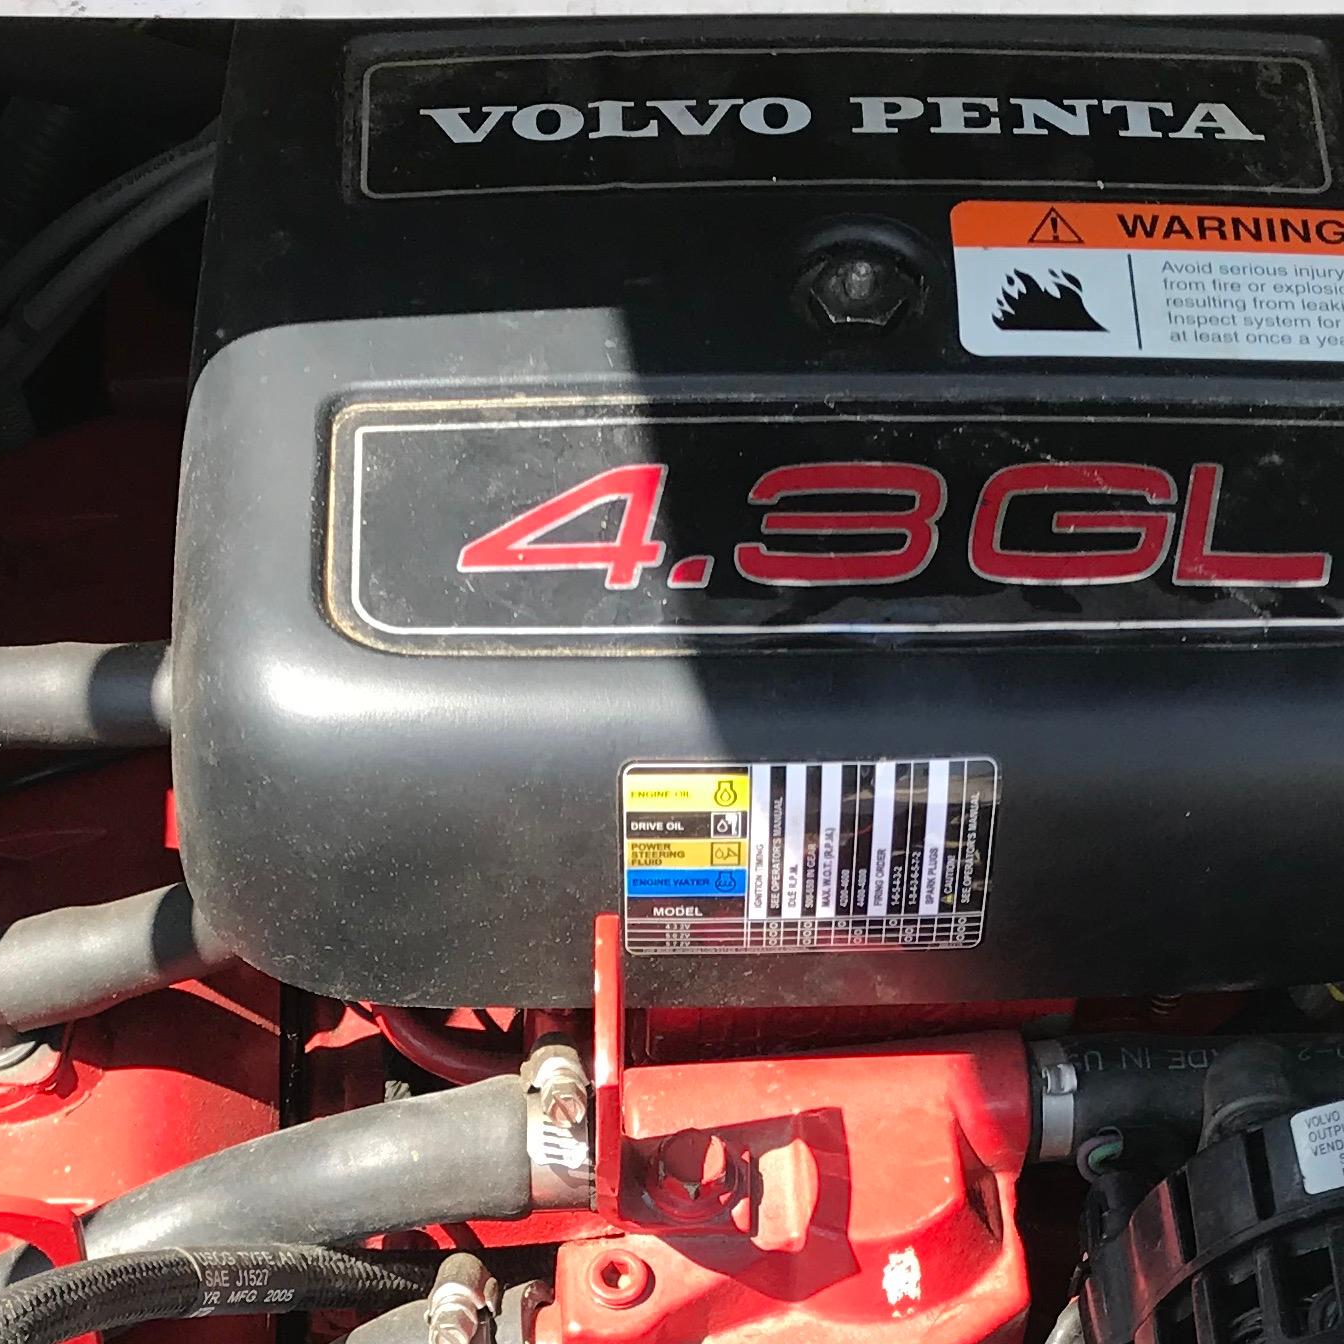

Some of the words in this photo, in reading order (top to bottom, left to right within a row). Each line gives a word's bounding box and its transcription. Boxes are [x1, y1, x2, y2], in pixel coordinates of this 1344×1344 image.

[419, 97, 813, 143] VOLVO
[849, 96, 1265, 142] PENTA
[1161, 260, 1213, 274] Avoid
[1219, 262, 1288, 277] serious
[1293, 264, 1344, 281] injury
[1163, 278, 1205, 292] from
[1212, 279, 1241, 292] fire
[1247, 282, 1266, 293] or
[1166, 295, 1247, 312] resulting
[1252, 296, 1295, 311] from
[1168, 312, 1237, 327] Inspect
[1243, 314, 1312, 330] system
[1317, 315, 1341, 329] for
[1170, 331, 1187, 343] at
[1194, 330, 1240, 343] least
[1246, 333, 1292, 345] once
[1299, 335, 1311, 345] a
[455, 462, 1332, 590] 4.3GL
[773, 797, 783, 837] MANUAL
[968, 792, 980, 831] MANUAL
[630, 821, 664, 832] DRIVE
[666, 821, 685, 832] OIL
[631, 843, 671, 851] POWER
[631, 851, 686, 859] STEERING
[807, 843, 817, 868] GEAR
[631, 858, 663, 866] FLUID
[754, 844, 764, 872] TIMING
[771, 837, 782, 891] OPERATOR'S
[875, 848, 886, 878] ORDER
[927, 848, 939, 875] PLUGS
[962, 831, 977, 886] OPERATOR'S
[632, 878, 671, 887] ENGINE
[672, 878, 711, 887] WATER
[754, 875, 763, 909] IGNITION
[924, 877, 937, 905] SPARK
[770, 893, 780, 909] SEE
[787, 891, 797, 908] IDLE
[873, 880, 885, 907] FIRING
[960, 887, 971, 904] SEE
[652, 906, 703, 917] MODEL
[1120, 1047, 1151, 1070] IN
[1167, 1048, 1219, 1070] DE
[1304, 1110, 1340, 1130] VOLVO
[205, 1269, 230, 1288] SAE
[235, 1268, 269, 1287] J1527
[202, 1290, 221, 1305] YR.
[263, 1288, 296, 1303] 2005
